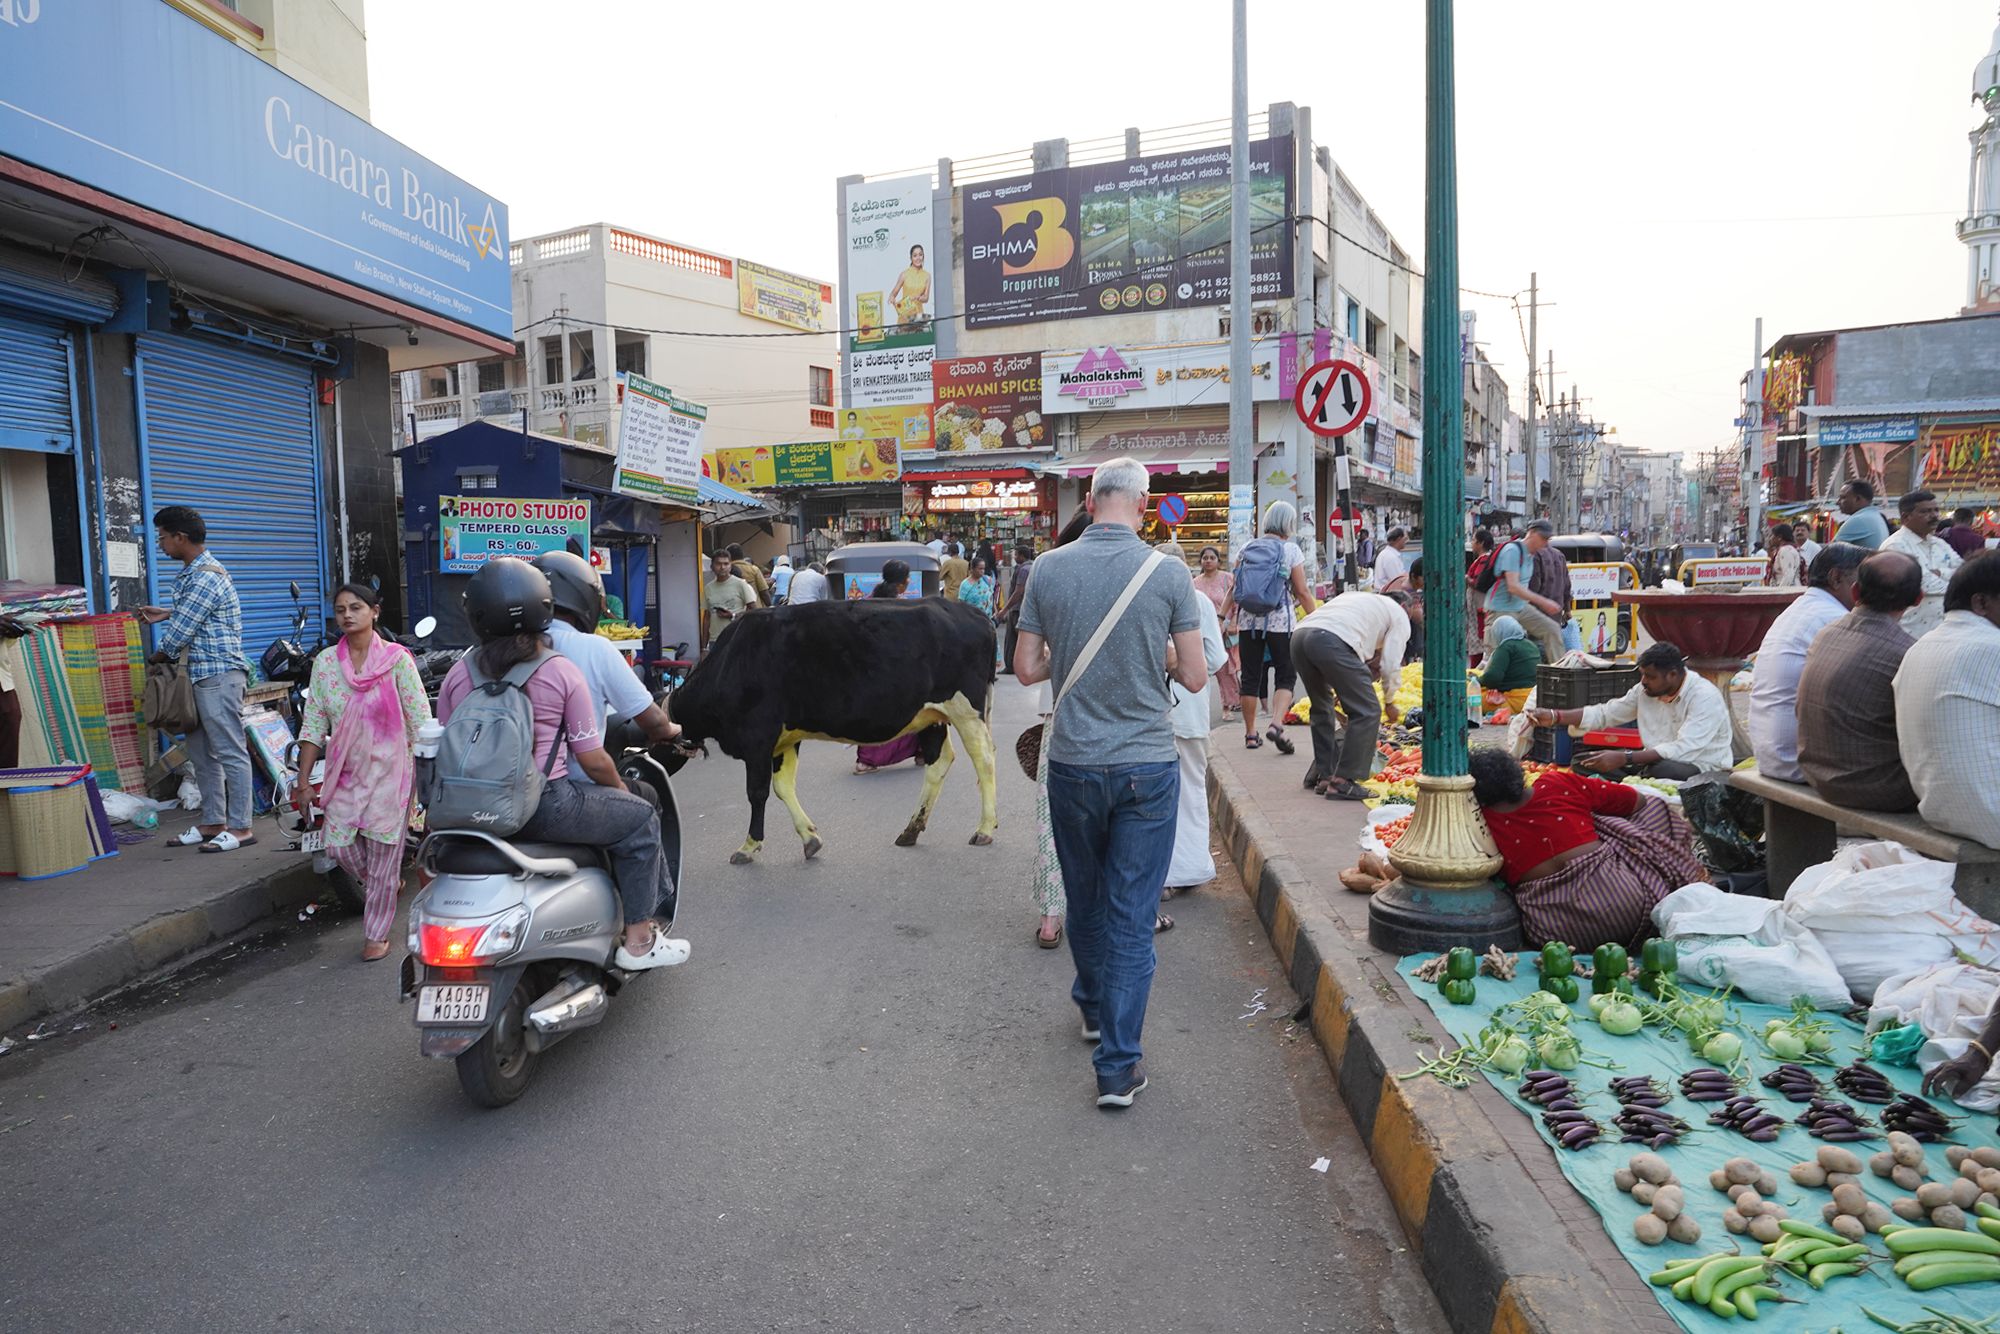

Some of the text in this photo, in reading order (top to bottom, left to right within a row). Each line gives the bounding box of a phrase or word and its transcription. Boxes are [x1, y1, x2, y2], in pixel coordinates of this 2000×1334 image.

[265, 96, 470, 248] Canara Bank
[360, 211, 471, 272] A Government of India Undertaking
[852, 235, 874, 245] VITO
[972, 238, 1037, 261] BHIMA
[1088, 260, 1122, 270] BHIMA
[1135, 254, 1174, 265] BHIMA
[354, 260, 372, 275] Main
[399, 276, 413, 292] New
[413, 281, 432, 299] Statue
[453, 301, 472, 314] Mysuru
[1003, 276, 1060, 293] Properties
[1195, 278, 1212, 288] +91
[1195, 290, 1212, 300] +91
[950, 361, 986, 377] ಭವಾನಿ
[1060, 367, 1142, 384] Mahalakshmi
[853, 377, 862, 388] SRI
[863, 373, 908, 387] VENKATESHWARA
[939, 383, 998, 400] BHAVANI
[1085, 386, 1119, 397] SWEETS
[1088, 397, 1114, 406] MYSURU
[1823, 428, 1915, 442] New Jupiter Store
[459, 501, 587, 521] PHOTO STUDIO
[460, 523, 567, 535] TEMPERD GLASS
[488, 540, 504, 550] RS
[516, 541, 538, 551] 60/-
[1698, 565, 1761, 578] Devaraja Traffic Police Station
[435, 987, 484, 1003] KA09H
[433, 1004, 481, 1019] M0300
